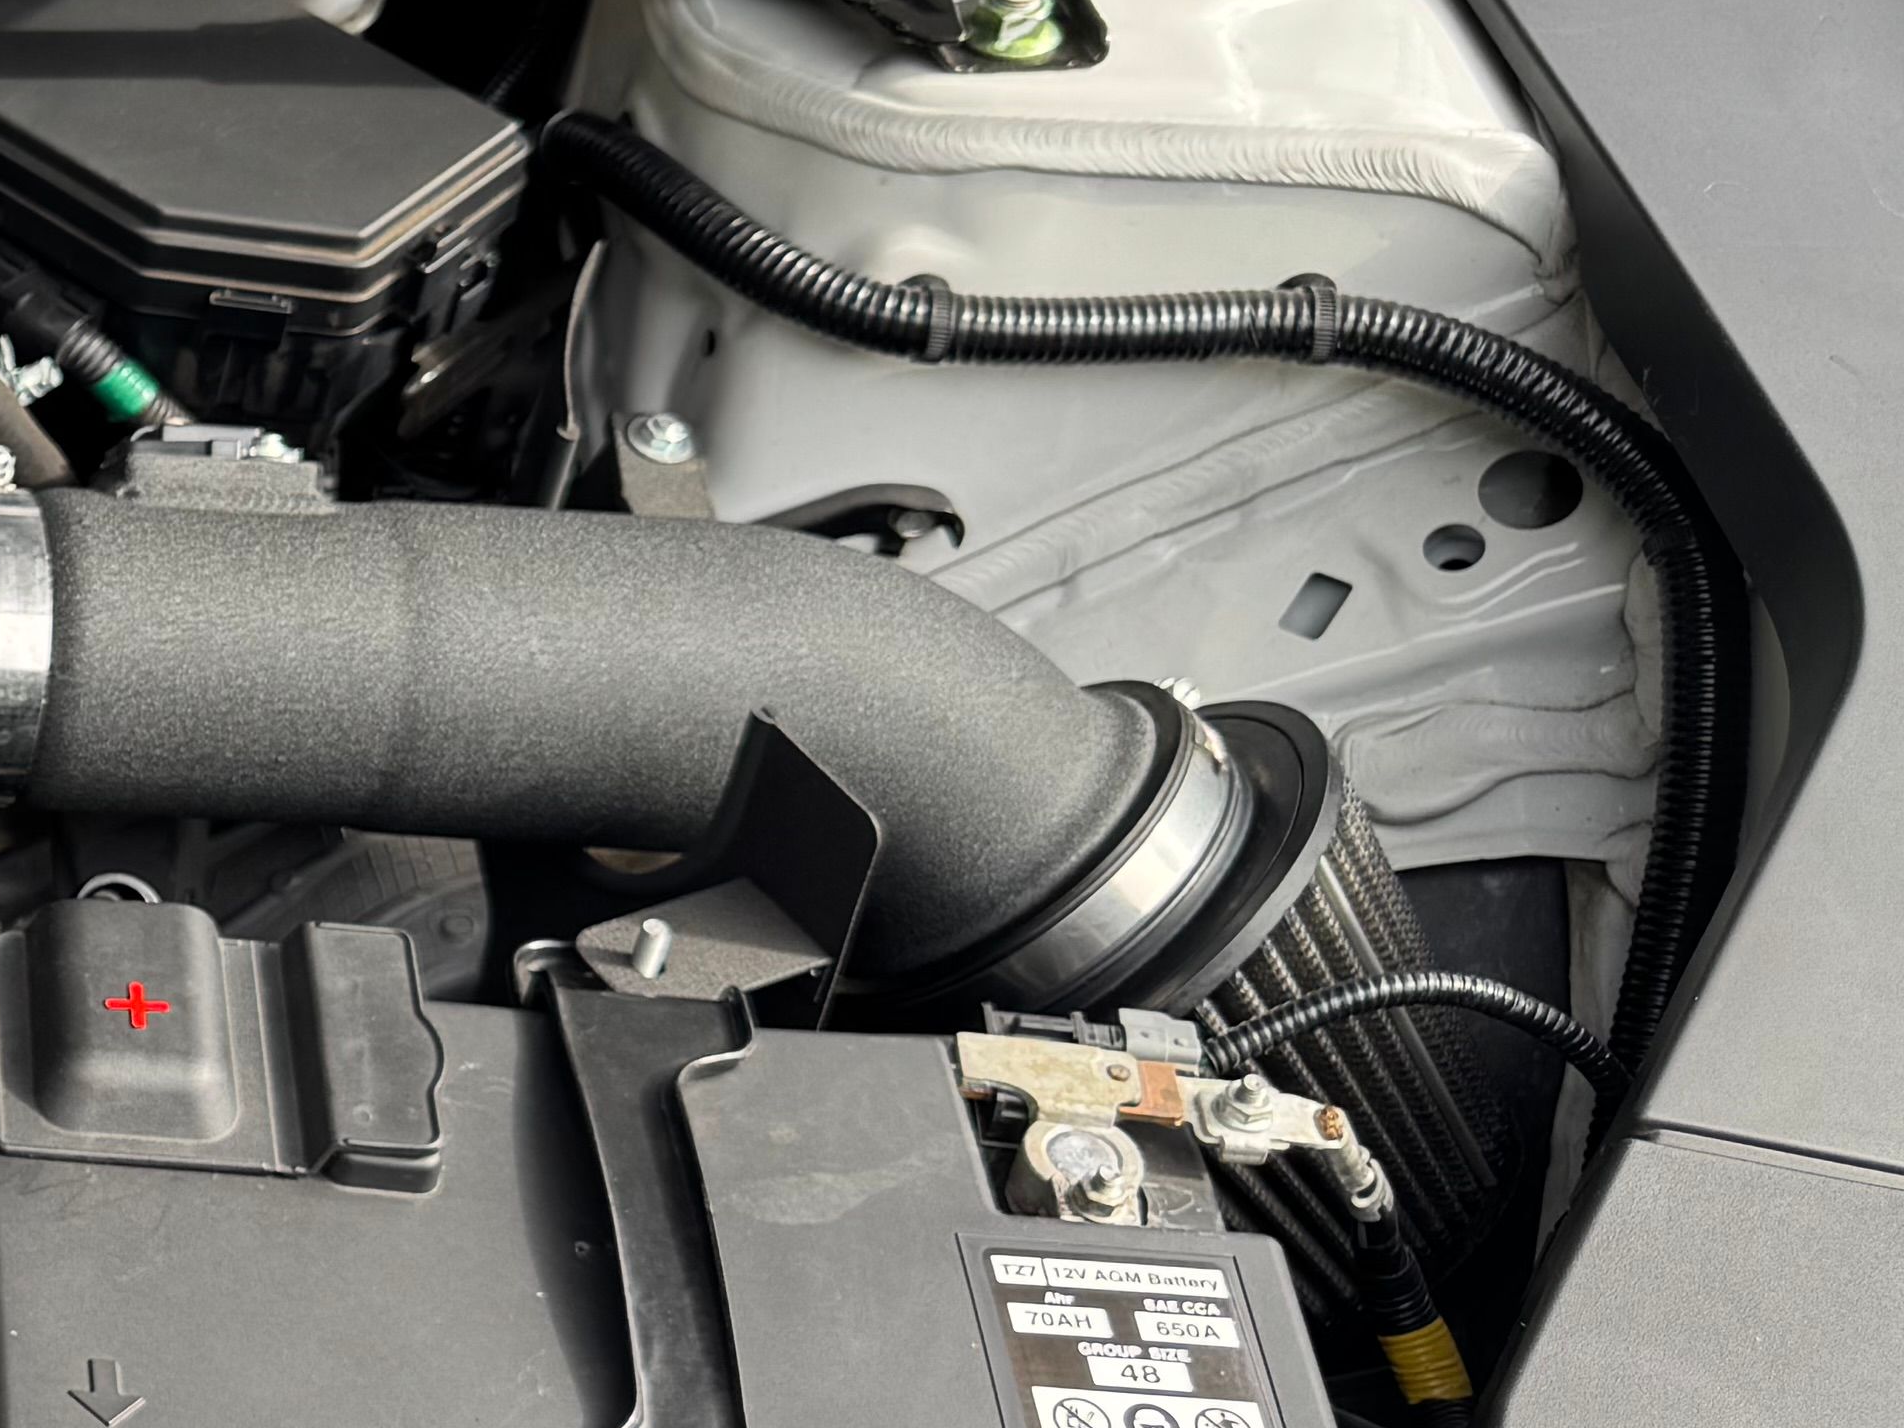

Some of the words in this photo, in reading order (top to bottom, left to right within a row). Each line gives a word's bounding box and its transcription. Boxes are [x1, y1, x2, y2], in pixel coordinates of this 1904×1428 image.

[1053, 1266, 1086, 1280] 12V
[1149, 1273, 1217, 1291] Battery
[1182, 1302, 1221, 1316] CCA
[1024, 1311, 1092, 1329] 70AH
[1156, 1321, 1220, 1340] 650A
[1078, 1342, 1142, 1358] GROUP
[1148, 1347, 1192, 1363] SIZE
[1121, 1364, 1161, 1383] 48
